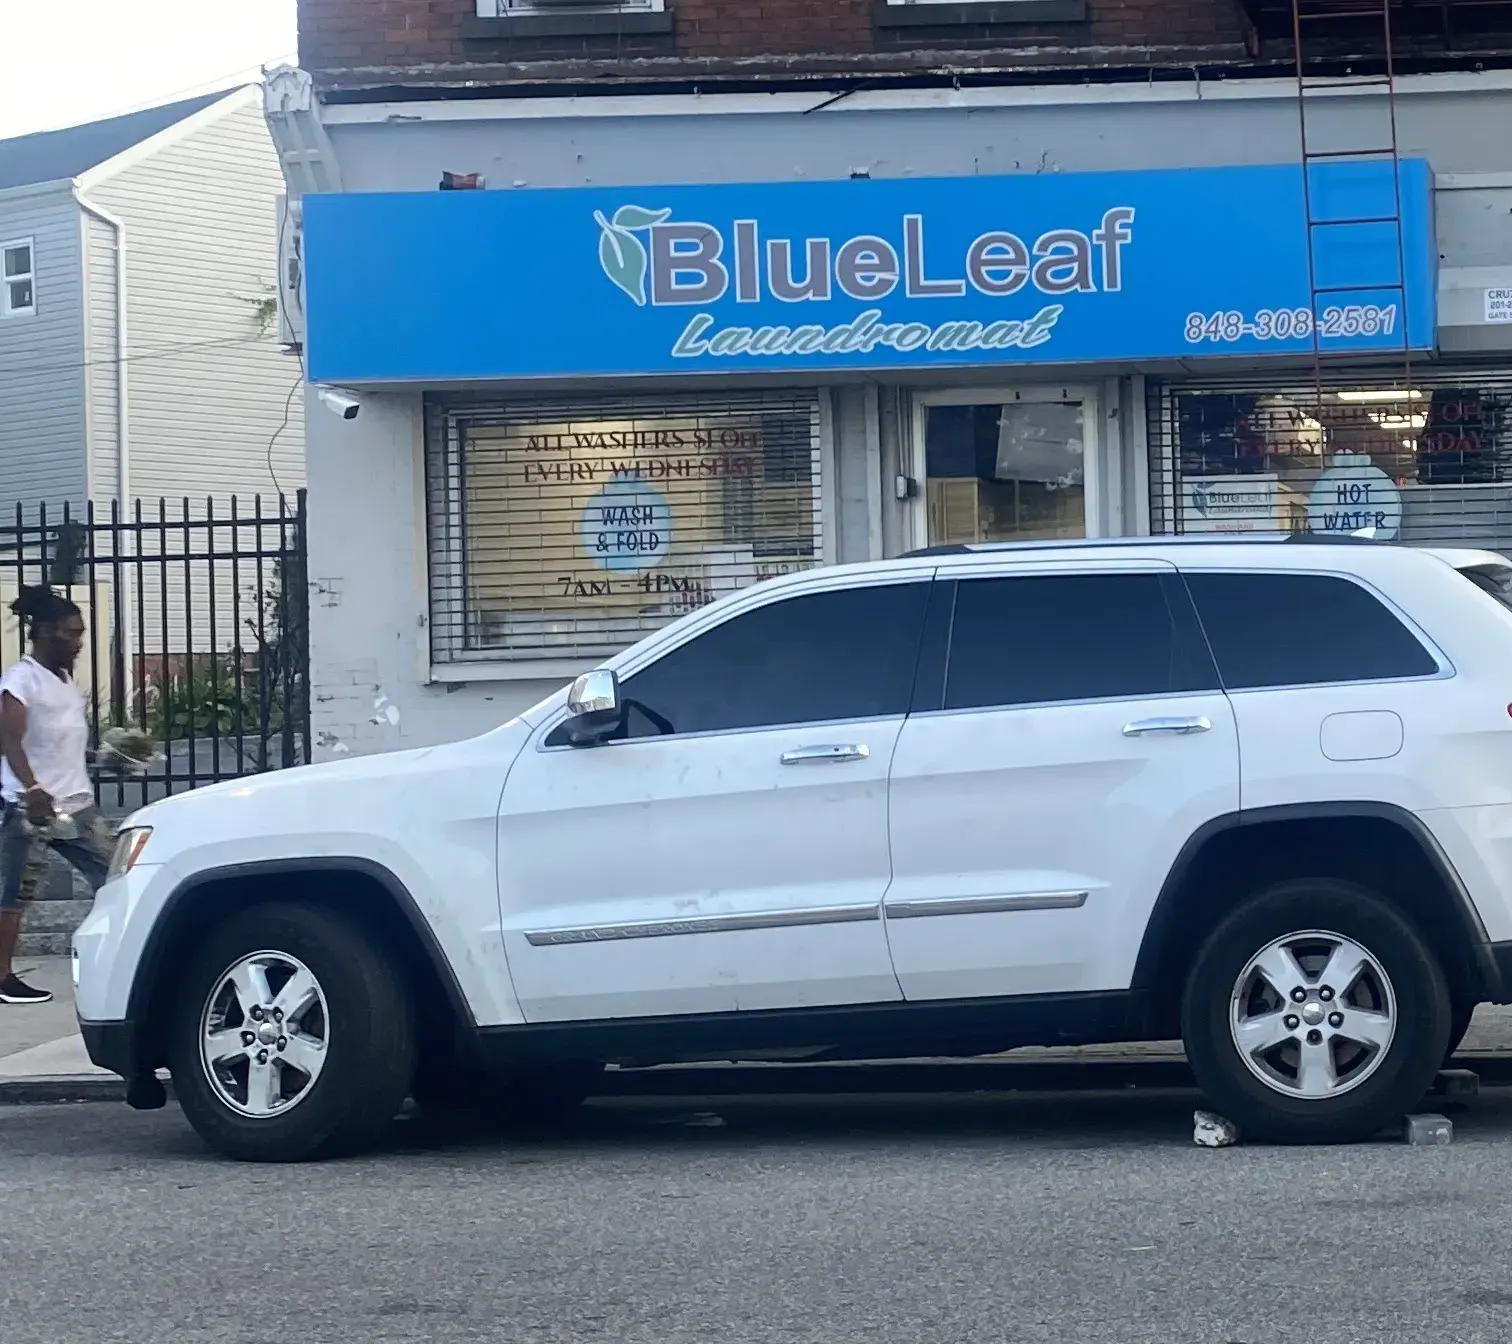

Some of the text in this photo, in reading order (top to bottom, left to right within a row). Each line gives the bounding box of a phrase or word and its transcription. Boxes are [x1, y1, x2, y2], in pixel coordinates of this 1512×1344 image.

[650, 207, 1136, 306] BlueLeaf
[1488, 311, 1509, 319] GATE
[671, 304, 1064, 358] Laundromat
[523, 461, 598, 483] EVERY
[1337, 483, 1372, 504] HOT
[602, 506, 655, 526] WASH
[596, 531, 660, 552] & FOLD
[557, 577, 611, 596] 7AM
